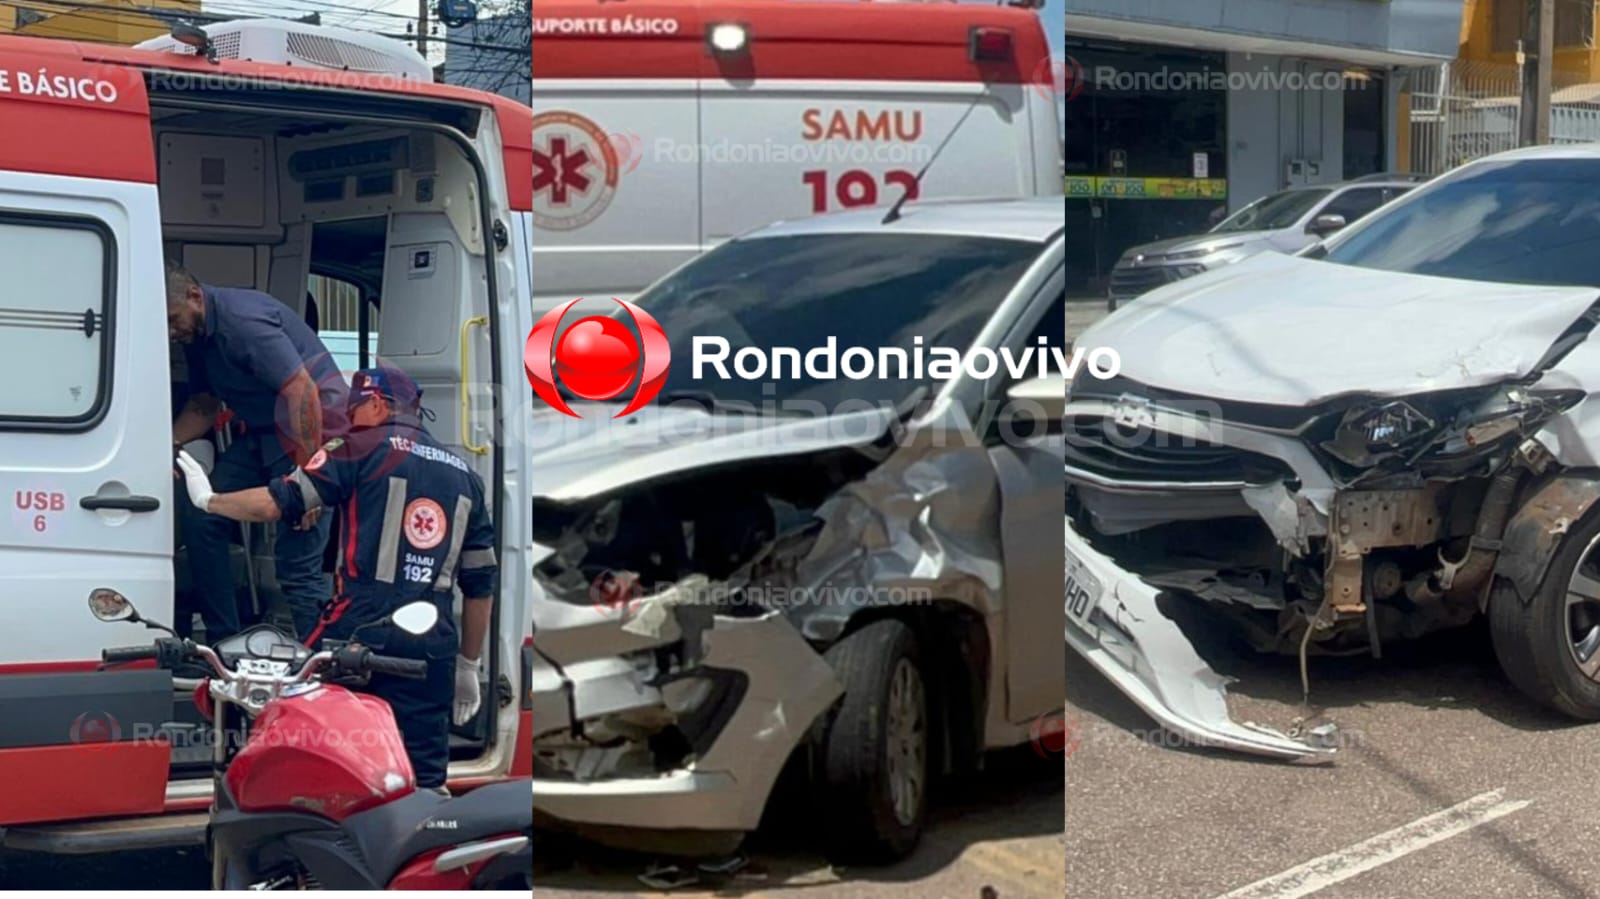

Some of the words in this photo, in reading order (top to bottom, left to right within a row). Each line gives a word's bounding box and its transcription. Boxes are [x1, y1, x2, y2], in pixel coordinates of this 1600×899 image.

[611, 14, 678, 33] BÁSICO
[17, 68, 118, 102] BÁSICO
[802, 109, 922, 142] SAMU
[16, 490, 65, 511] USB
[34, 515, 46, 532] 6
[405, 553, 434, 566] SAMU
[403, 564, 432, 583] 192
